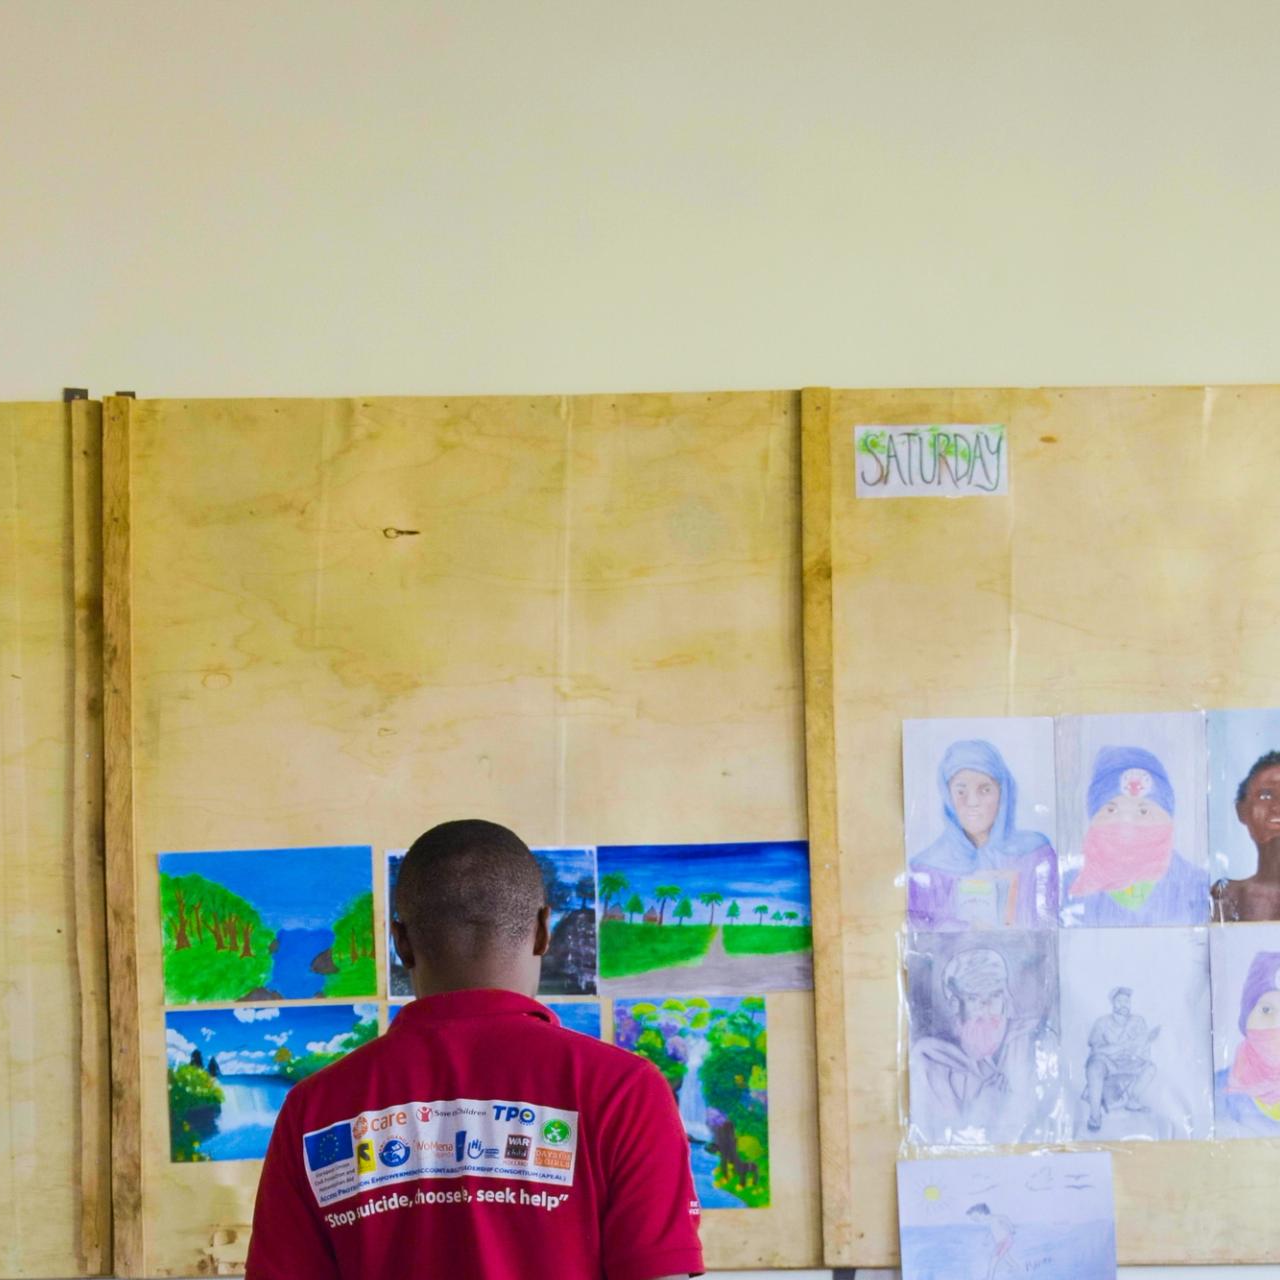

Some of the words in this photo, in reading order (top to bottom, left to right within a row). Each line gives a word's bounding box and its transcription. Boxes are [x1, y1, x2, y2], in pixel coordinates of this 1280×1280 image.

[860, 430, 1005, 492] SATURDAY
[370, 1111, 408, 1132] care
[508, 1137, 530, 1147] WAR
[476, 1187, 518, 1203] seek
